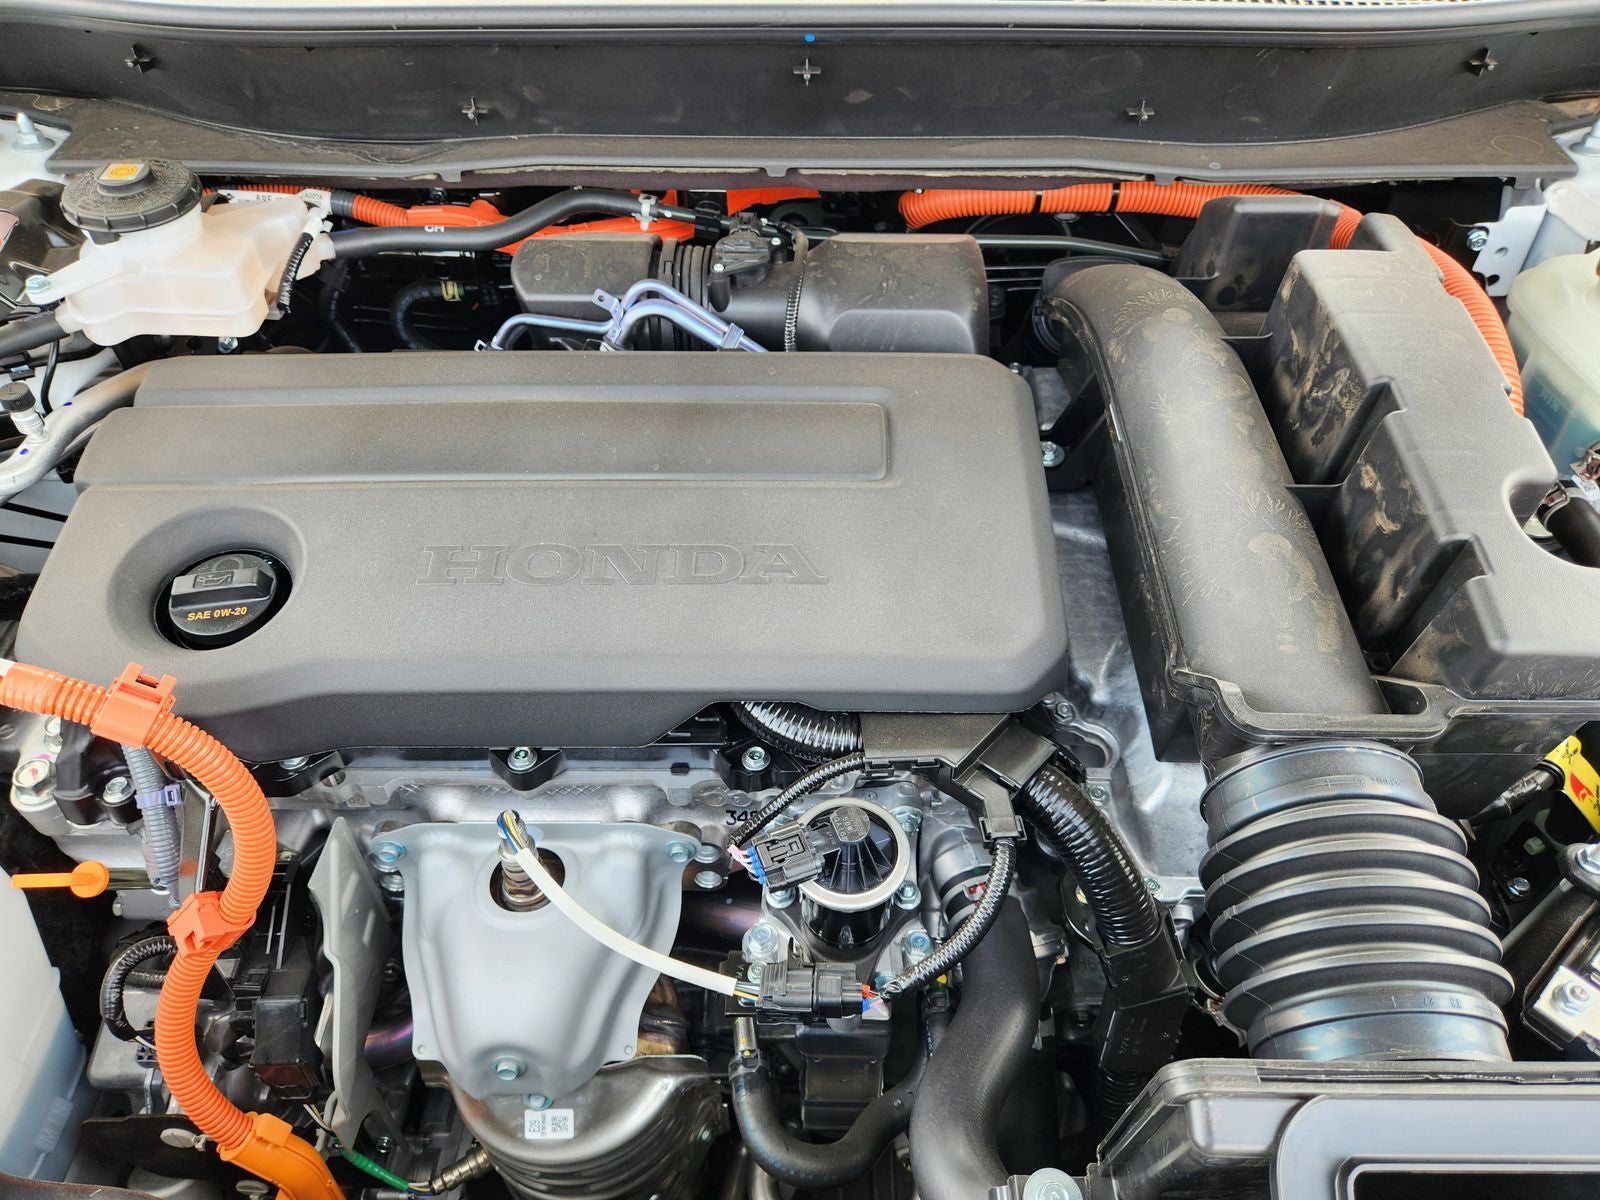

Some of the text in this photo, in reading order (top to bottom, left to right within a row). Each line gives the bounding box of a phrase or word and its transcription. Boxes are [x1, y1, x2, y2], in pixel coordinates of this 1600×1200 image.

[414, 543, 830, 586] HONDA
[187, 606, 248, 621] SAE 0W-20
